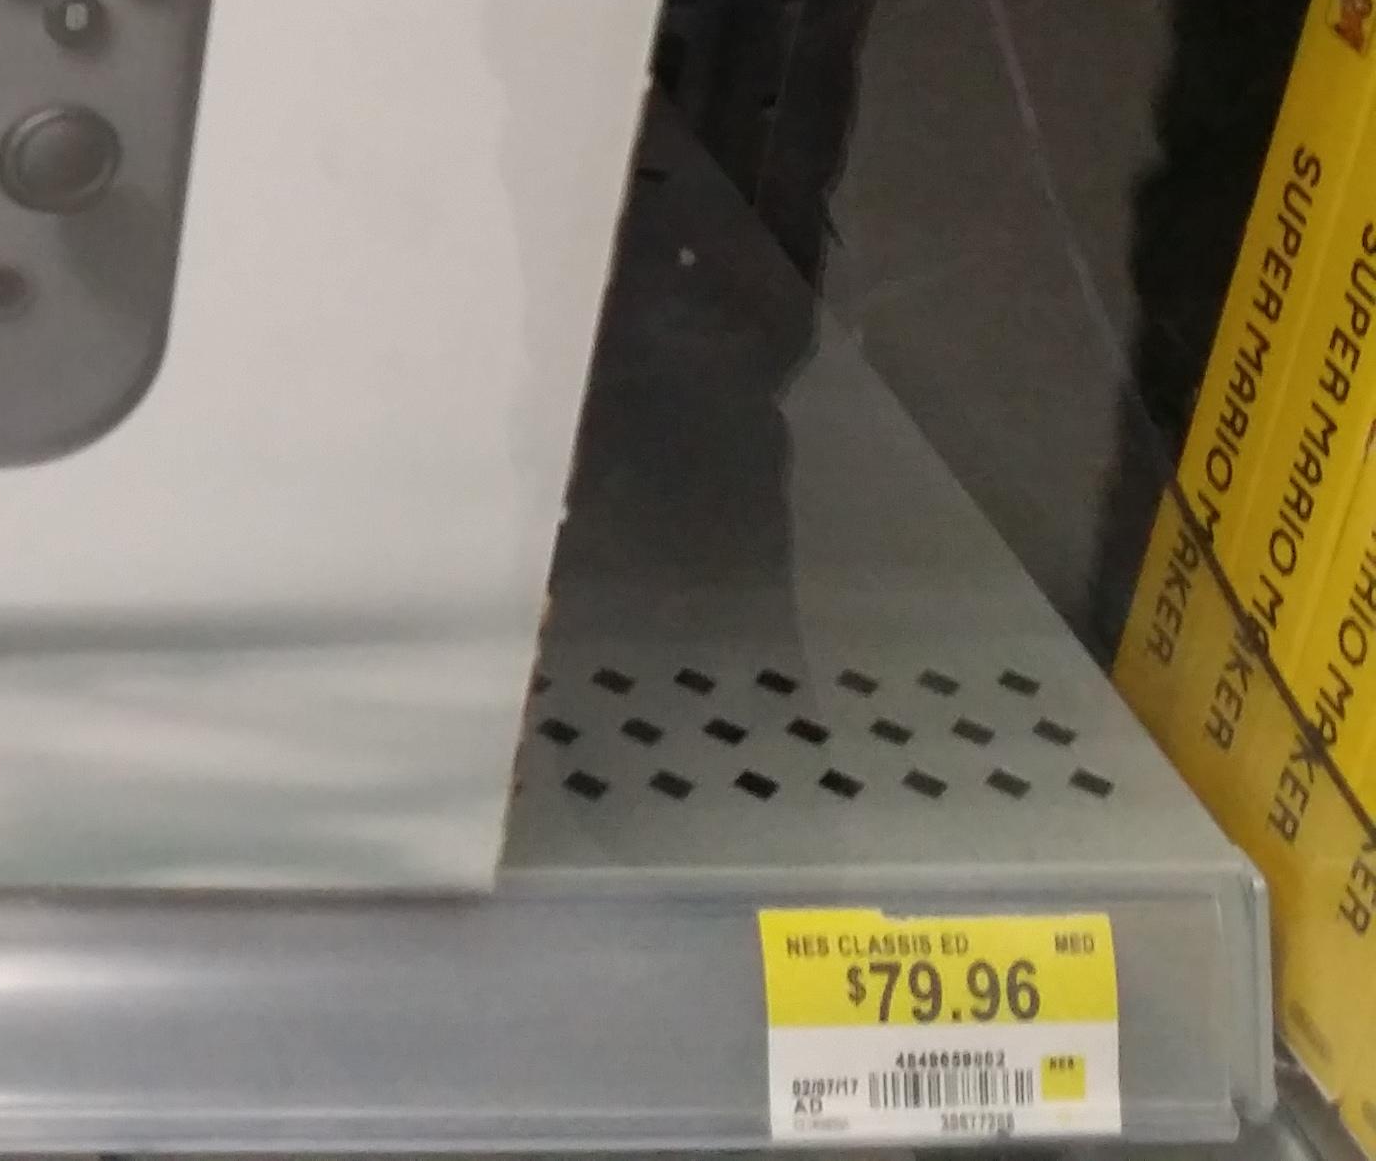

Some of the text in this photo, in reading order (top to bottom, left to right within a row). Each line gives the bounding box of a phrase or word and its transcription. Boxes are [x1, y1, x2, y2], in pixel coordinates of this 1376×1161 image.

[1252, 142, 1323, 325] SUPER
[1204, 321, 1271, 494] MARIO
[1268, 399, 1338, 578] MARIO
[846, 958, 1042, 1024] $79.96
[940, 934, 970, 957] ED
[793, 1097, 824, 1115] AD
